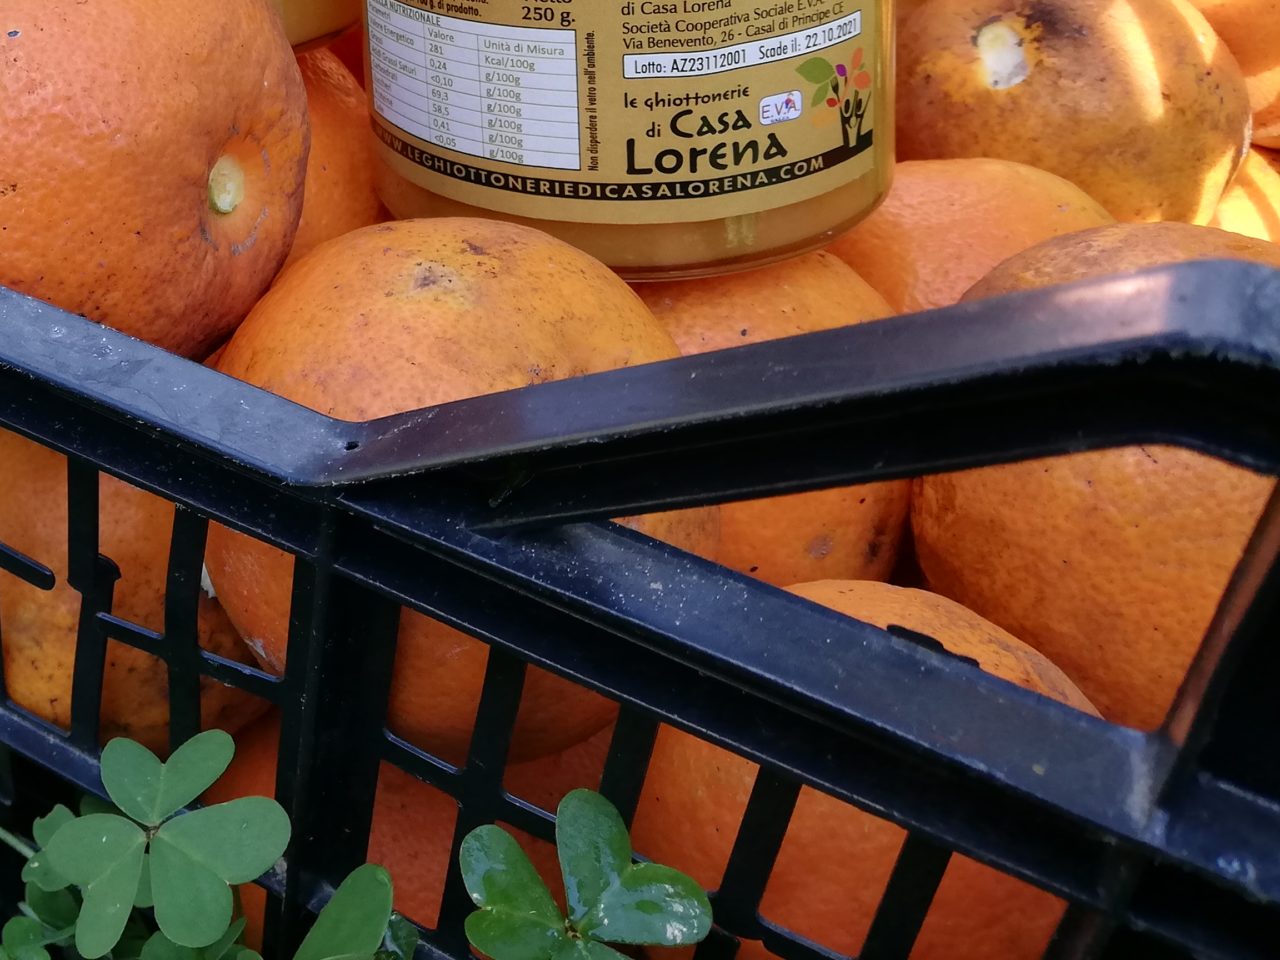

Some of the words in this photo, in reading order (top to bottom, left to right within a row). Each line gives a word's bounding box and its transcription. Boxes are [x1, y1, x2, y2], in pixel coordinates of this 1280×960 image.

[389, 0, 441, 26] NUTRIZIONALE
[446, 0, 482, 17] prodotto.
[621, 2, 635, 15] di
[640, 1, 677, 15] Casa
[521, 5, 558, 23] 250
[559, 8, 576, 28] g.
[622, 19, 671, 35] Società
[675, 12, 750, 33] Cooperativa
[753, 2, 794, 20] Sociale
[427, 27, 455, 43] Valore
[623, 37, 643, 50] Via
[647, 35, 717, 49] Benevento,
[720, 31, 735, 43] 26
[745, 21, 775, 37] Casal
[778, 17, 789, 31] di
[791, 8, 831, 29] Principe
[429, 43, 443, 56] 281
[484, 39, 511, 53] Unità
[514, 41, 524, 53] di
[526, 43, 565, 56] Misura
[634, 60, 667, 74] Lotto:
[670, 48, 746, 73] AZ23112001
[759, 44, 788, 60] Scade
[790, 40, 801, 54] il:
[804, 19, 858, 49] 22.10.2021
[429, 58, 447, 71] 0,24
[484, 56, 535, 71] Kcal/100g
[583, 30, 596, 85] nell'ambiente.
[431, 74, 453, 88] <0,10
[485, 71, 521, 86] g/100g
[432, 88, 449, 102] 69,3
[486, 87, 522, 101] g/100g
[586, 87, 597, 106] vetro
[624, 92, 638, 108] le
[644, 85, 750, 111] ghiottonerie
[432, 103, 450, 116] 58,5
[487, 102, 522, 117] g/100g
[433, 118, 450, 131] 0,41
[488, 118, 523, 133] g/100g
[646, 122, 661, 138] di
[670, 109, 752, 138] Casa
[488, 134, 523, 148] g/100g
[586, 115, 601, 155] disperdere
[489, 149, 524, 163] g/100g
[626, 132, 788, 175] Lorena
[587, 156, 599, 171] Non
